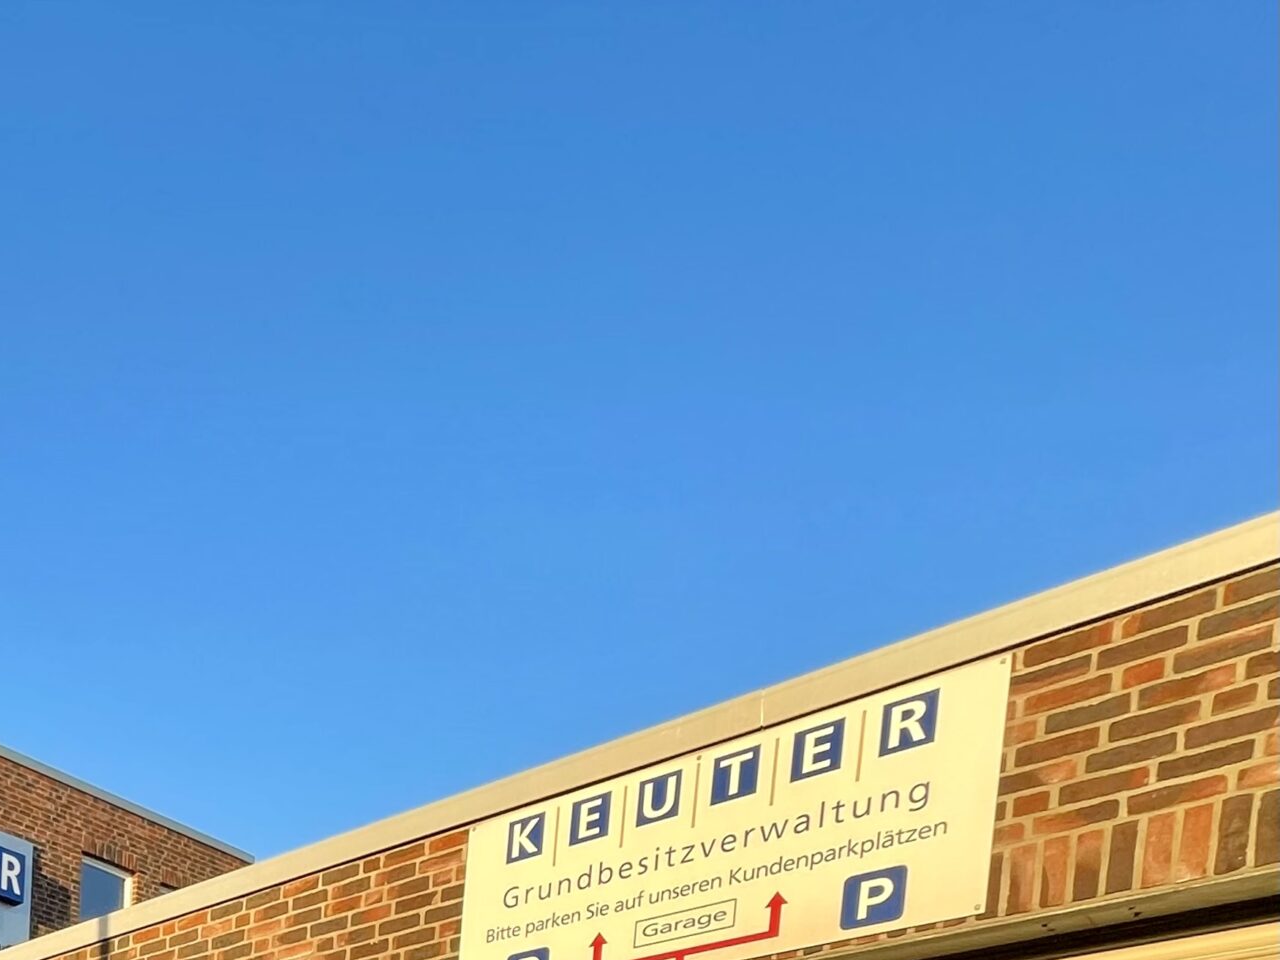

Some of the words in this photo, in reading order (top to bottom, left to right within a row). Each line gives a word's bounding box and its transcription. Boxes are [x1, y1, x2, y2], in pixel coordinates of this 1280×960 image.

[510, 698, 929, 861] KEUTER
[486, 925, 522, 944] Bitte
[524, 908, 581, 938] parken
[586, 901, 610, 920] Sie
[614, 892, 645, 913] auf
[648, 874, 723, 903] unseren
[729, 819, 948, 886] Kundenparkplätzen
[503, 780, 932, 909] Grundbesitzverwaltung
[855, 876, 895, 921] P
[641, 907, 728, 939] Garage
